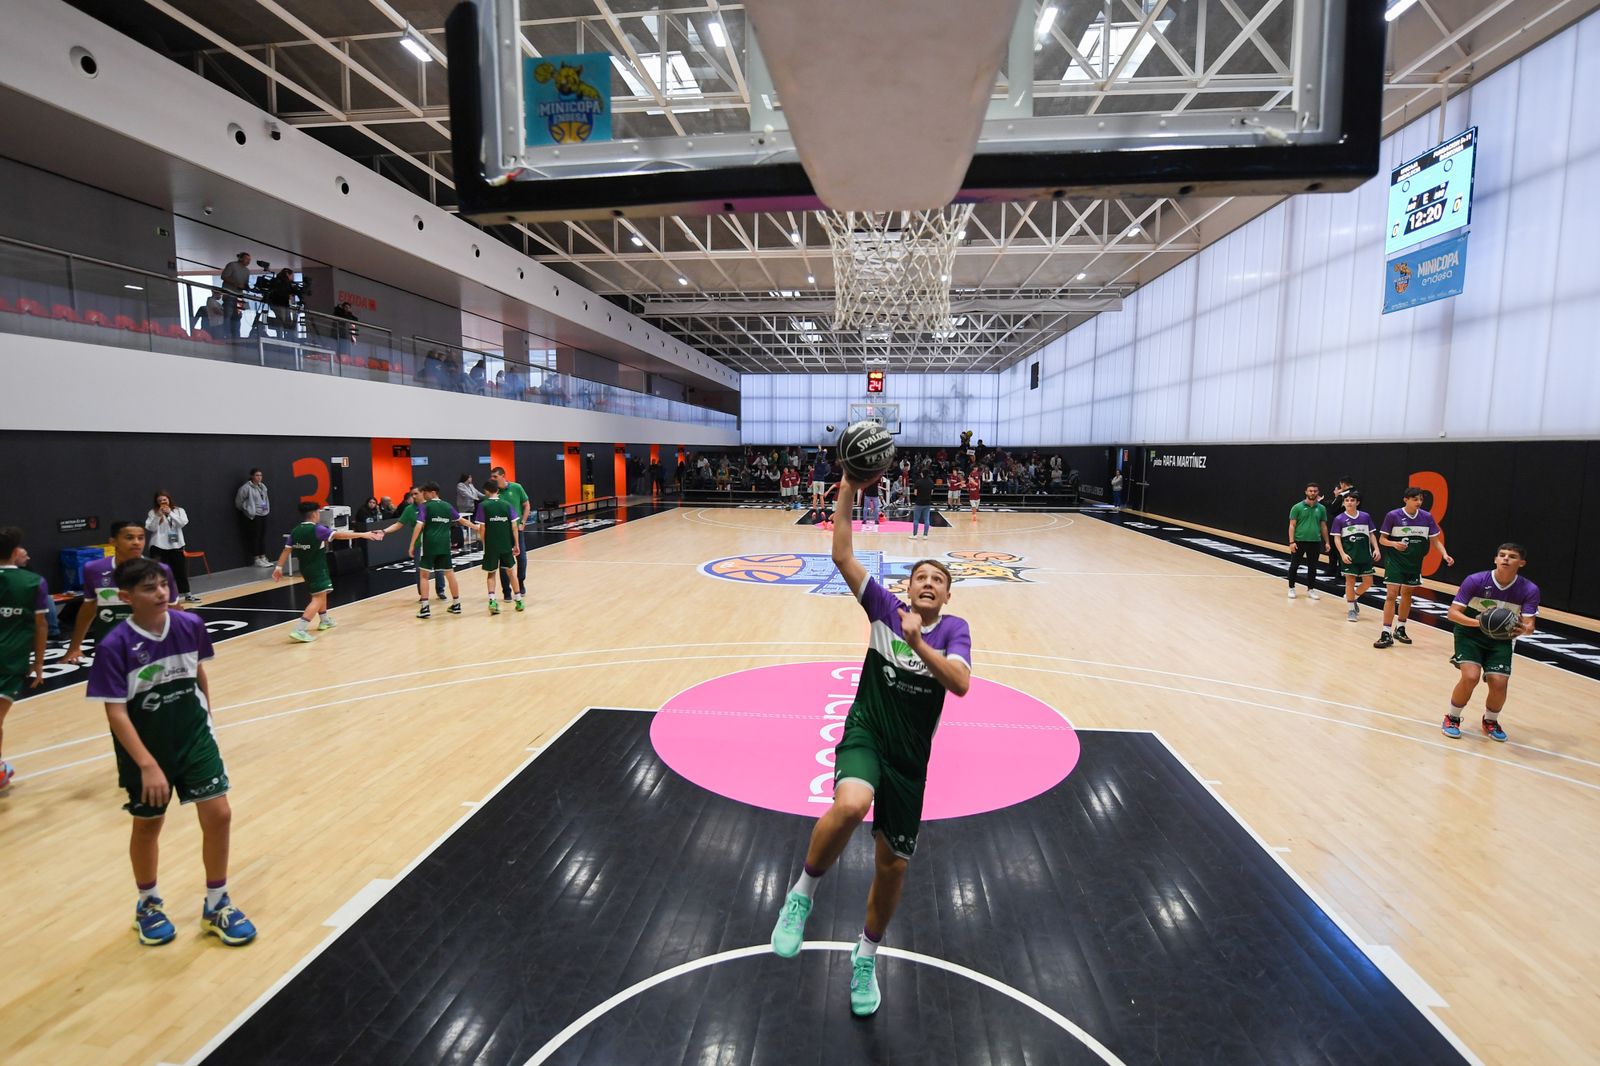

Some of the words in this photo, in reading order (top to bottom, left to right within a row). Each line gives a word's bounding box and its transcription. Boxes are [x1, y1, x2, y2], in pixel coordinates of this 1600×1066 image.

[539, 101, 601, 116] MINICOPA
[1409, 203, 1442, 230] 12:20
[1418, 252, 1458, 278] MINICOPA
[1421, 270, 1453, 286] endesa
[868, 381, 881, 391] 24
[1163, 456, 1176, 466] RAFA
[1176, 452, 1206, 468] MARTÍNEZ
